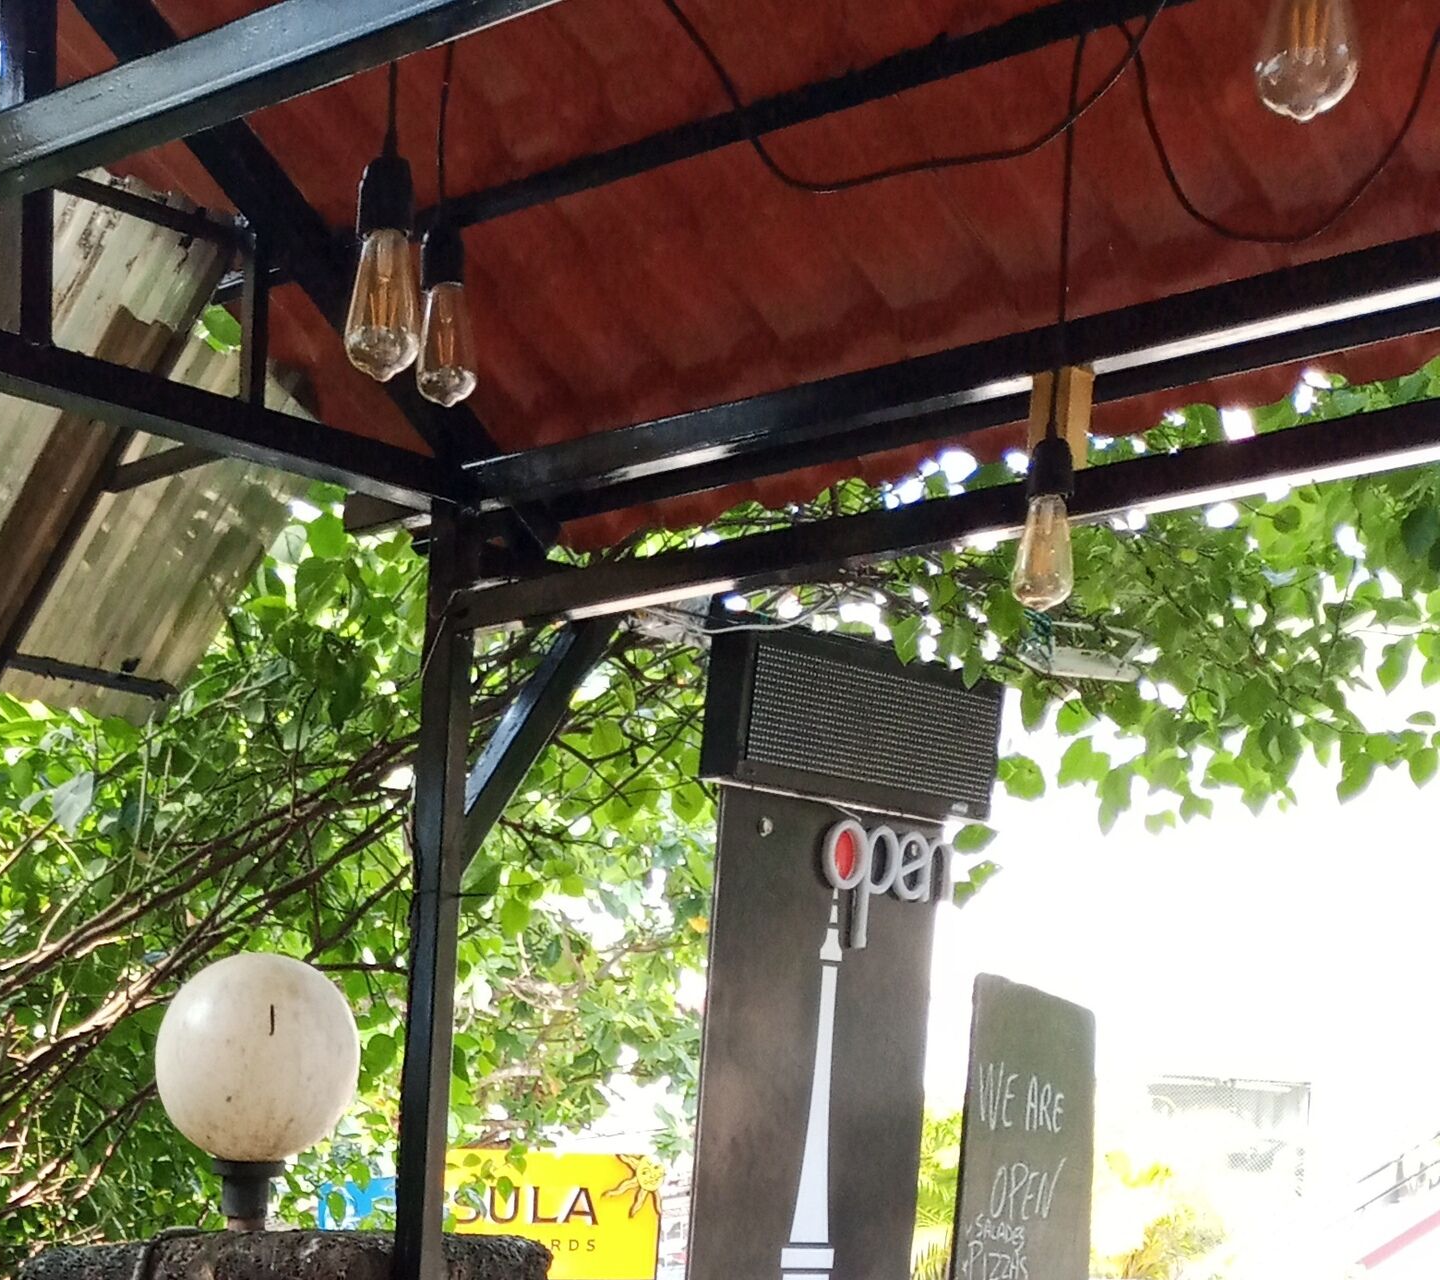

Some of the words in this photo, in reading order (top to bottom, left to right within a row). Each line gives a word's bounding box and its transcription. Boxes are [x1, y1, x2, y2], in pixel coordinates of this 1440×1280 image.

[979, 1061, 1019, 1130] WE
[1025, 1074, 1065, 1134] ARE
[453, 1185, 599, 1226] SULA
[990, 1157, 1067, 1221] OPEN
